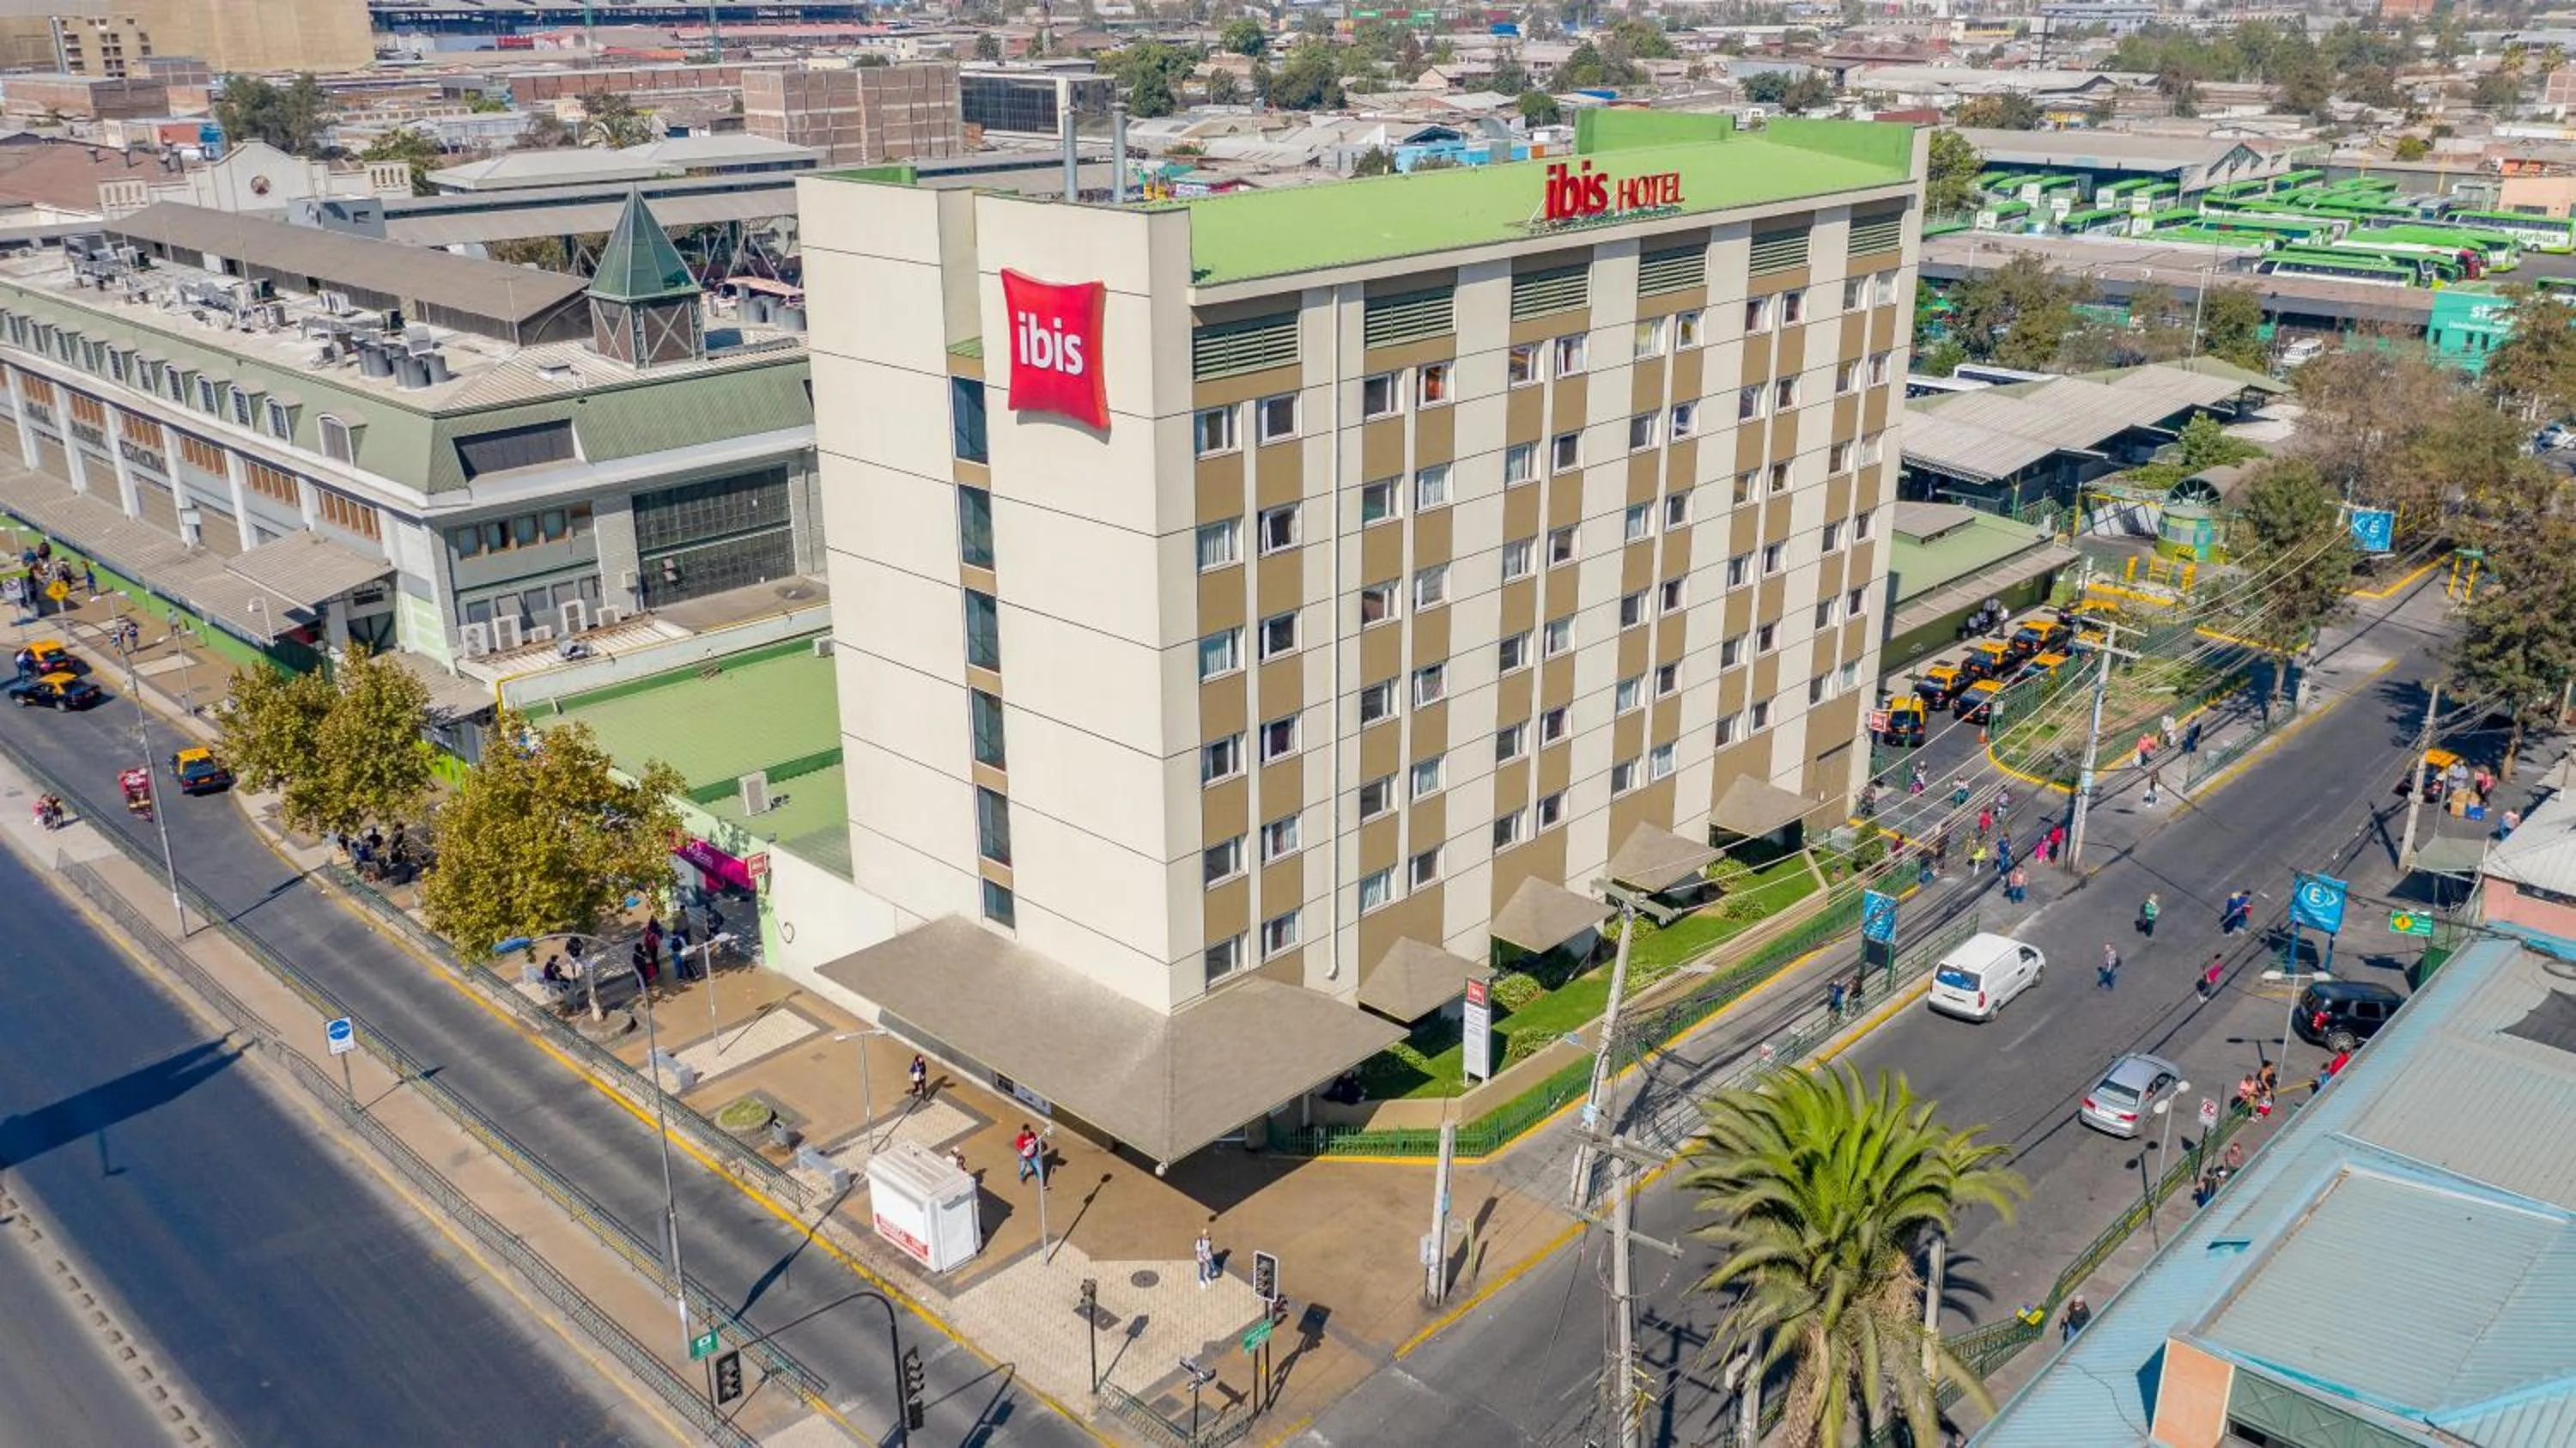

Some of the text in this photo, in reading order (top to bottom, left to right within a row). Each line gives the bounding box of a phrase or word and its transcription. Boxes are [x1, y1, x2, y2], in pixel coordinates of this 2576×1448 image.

[1545, 159, 1685, 220] ibis HOTEL
[1018, 310, 1084, 375] ibis
